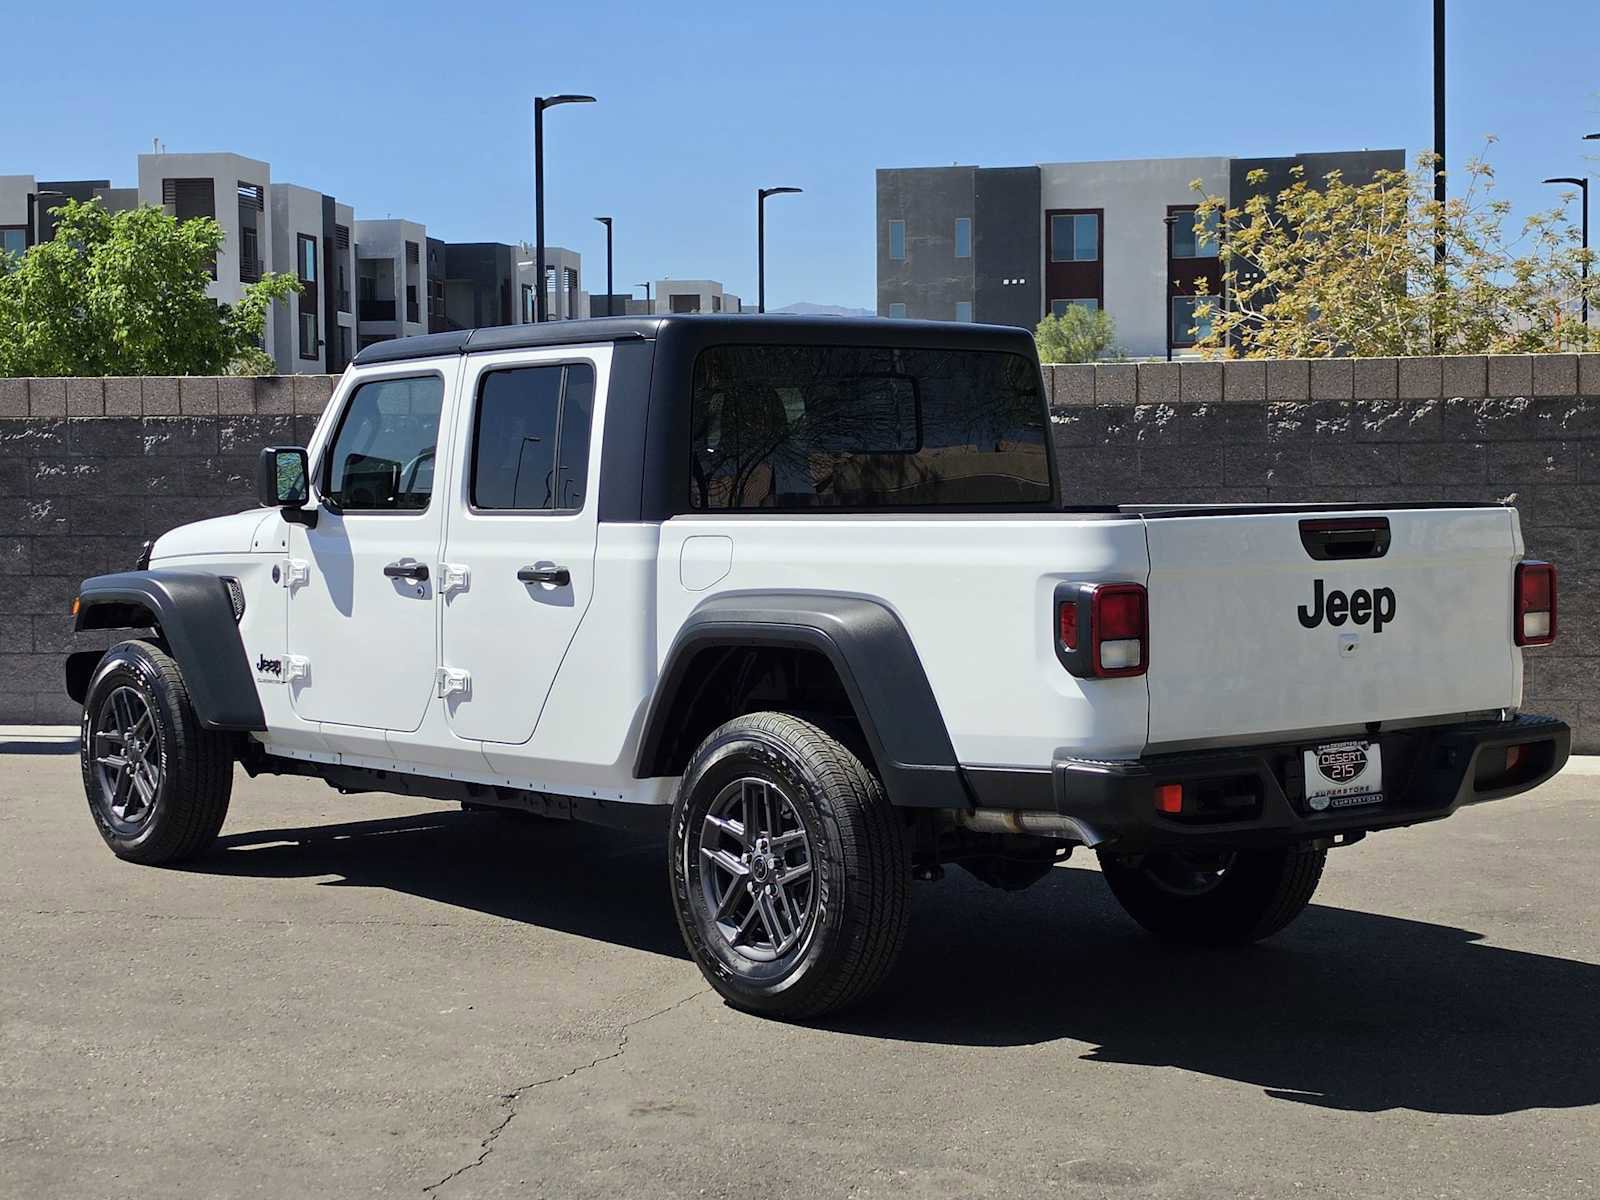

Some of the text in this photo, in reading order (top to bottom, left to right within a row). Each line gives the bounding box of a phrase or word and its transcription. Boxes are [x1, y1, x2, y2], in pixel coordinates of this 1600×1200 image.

[1297, 579, 1396, 633] Jeep
[256, 653, 281, 679] Jeep
[1321, 751, 1361, 765] DESERT
[1332, 764, 1355, 779] 215
[1315, 785, 1370, 797] SUPERSTORE
